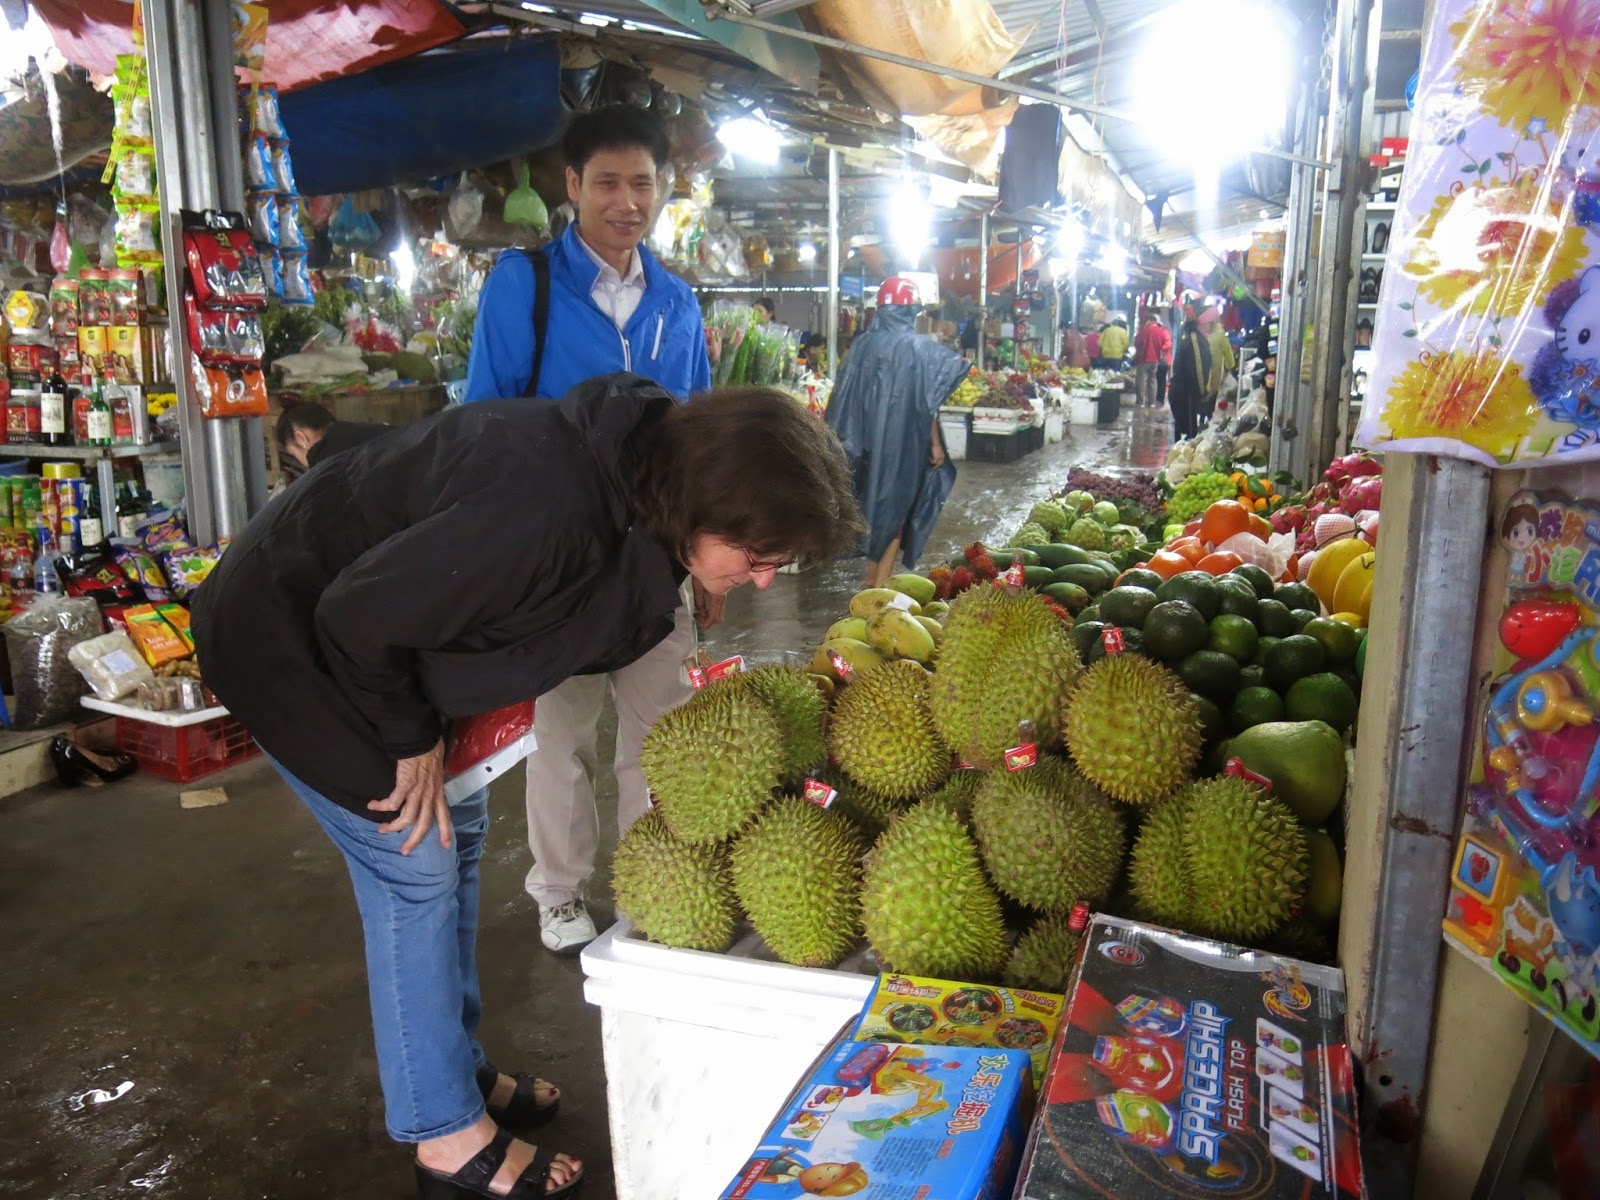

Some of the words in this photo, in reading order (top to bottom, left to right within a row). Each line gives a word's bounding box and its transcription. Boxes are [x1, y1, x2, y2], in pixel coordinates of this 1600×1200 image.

[1177, 1000, 1230, 1164] SPACESHIP
[1231, 1040, 1247, 1068] TOP
[947, 1054, 1010, 1136] 欢乐挖掘机
[1227, 1077, 1245, 1131] FLASH
